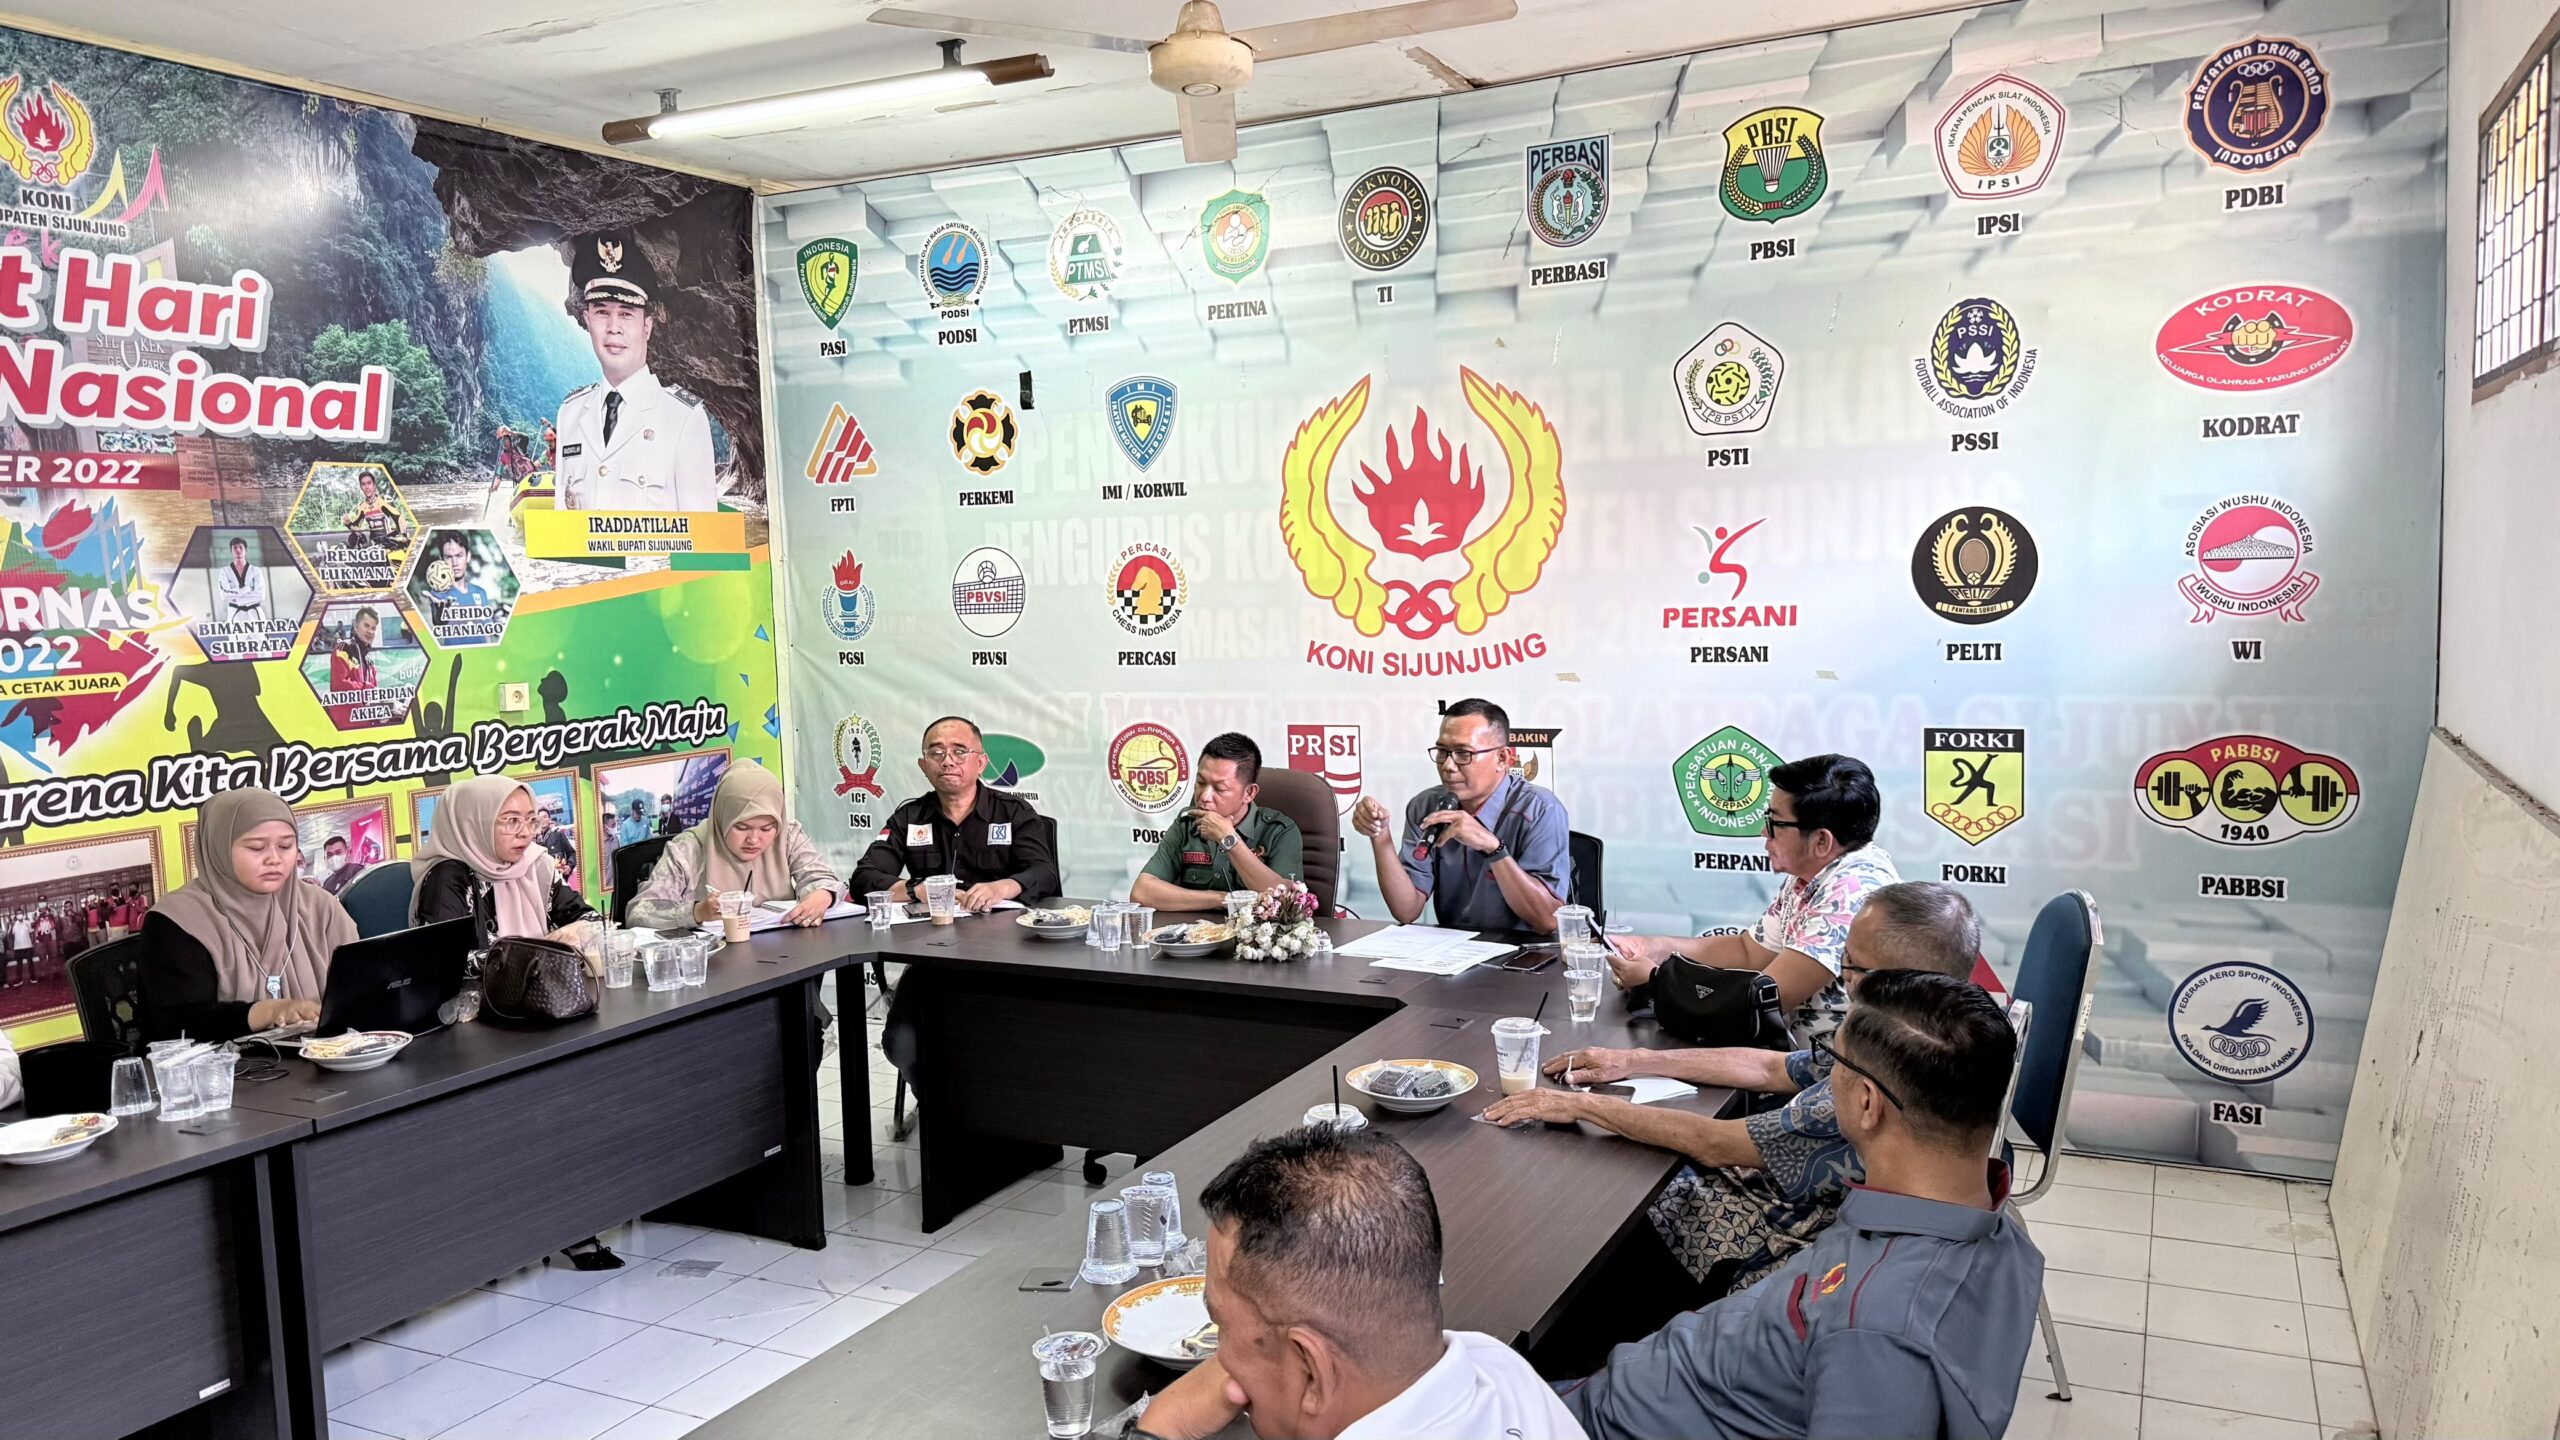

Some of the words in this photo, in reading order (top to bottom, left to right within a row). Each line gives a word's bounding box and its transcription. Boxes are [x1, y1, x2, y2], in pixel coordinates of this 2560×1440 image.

[2192, 45, 2252, 110] PERSATUAN
[2257, 43, 2301, 63] DRUM
[2299, 56, 2322, 95] BAND
[1948, 117, 1964, 147] IKATAN
[1962, 94, 1997, 117] PENCAK
[1998, 91, 2023, 101] SILAT
[2023, 96, 2051, 136] INDONESIA
[1745, 117, 1798, 148] PBSI
[1531, 139, 1604, 176] PERBASI
[2215, 139, 2297, 165] INDONESIA
[1978, 175, 2020, 190] IPSI
[22, 189, 72, 211] KONI
[1346, 172, 1422, 215] TAEKWONDO
[2225, 184, 2284, 210] PDBI
[52, 215, 127, 238] SIJUNJUNG
[930, 225, 945, 240] RAGA
[946, 223, 969, 231] DAYUNG
[1977, 213, 2020, 235] IPSI
[803, 242, 849, 258] INDONESIA
[970, 228, 987, 256] SELURUH
[1347, 229, 1421, 264] INDONESIA
[1751, 239, 1795, 261] PBSI
[848, 259, 857, 295] Indonesia
[920, 259, 934, 299] PERSATUAN
[975, 258, 989, 295] INDONESIA
[1066, 260, 1110, 282] PTMSI
[1531, 261, 1606, 286] PERBASI
[800, 263, 813, 302] Persatuan
[62, 256, 260, 341] Hari
[1377, 286, 1392, 303] TI
[2194, 289, 2314, 317] KODRAT
[941, 309, 969, 319] PODSI
[1208, 301, 1267, 321] PERTINA
[1069, 316, 1109, 333] PTMSI
[1957, 325, 1994, 339] PSSI
[938, 329, 977, 345] PODSI
[820, 341, 846, 356] PASI
[2158, 353, 2204, 382] KELUARGA
[2206, 376, 2264, 385] OLAHRAGA
[2265, 368, 2308, 383] TARUNG
[2309, 339, 2350, 372] DERAJAT
[0, 345, 384, 433] Nasional
[1126, 383, 1156, 393] IMI
[1914, 357, 1940, 402] FOOTBALL
[1936, 398, 1995, 419] ASSOCIATION
[1996, 396, 2009, 409] OF
[2008, 348, 2038, 399] INDONESIA
[1724, 408, 1749, 424] PSTI
[2203, 414, 2300, 438] KODRAT
[1111, 401, 1124, 432] IKATAN
[1120, 433, 1142, 460] MOTOR
[1145, 395, 1172, 460] INDONESIA
[1951, 432, 1999, 451] PSSI
[1707, 448, 1749, 467] PSTI
[50, 458, 143, 484] 2022
[959, 490, 1014, 506] PERKEMI
[1102, 485, 1123, 500] IMI
[1133, 482, 1187, 499] KORWIL
[831, 498, 855, 512] FPTI
[589, 518, 689, 533] IRADDATILLAH
[2185, 506, 2219, 557] ASOSIASI
[2219, 494, 2269, 510] WUSHU
[2271, 498, 2313, 554] INDONESIA
[327, 549, 386, 562] RENGGI
[588, 540, 615, 552] WAKIL
[618, 540, 647, 552] BUPATI
[648, 540, 692, 551] SIJUNJUNG
[1120, 542, 1172, 560] PERCASI
[320, 567, 396, 581] LUKMANA
[966, 590, 1007, 603] PBVSI
[1950, 588, 1999, 600] PELTI
[2197, 583, 2235, 610] WUSHU
[2238, 583, 2302, 611] INDONESIA
[0, 586, 160, 631] RNAS
[442, 607, 493, 620] AFRIDO
[1663, 605, 1798, 629] PERSANI
[1951, 606, 1978, 614] PANTANG
[1979, 605, 1998, 613] SURUT
[199, 618, 300, 636] BIMANTARA
[432, 623, 503, 638] CHANIAGO
[1112, 609, 1137, 634] CHESS
[1138, 608, 1182, 637] INDONESIA
[211, 640, 291, 656] SUBRATA
[1306, 640, 1374, 674] KONI
[1383, 633, 1547, 677] SIJUNJUNG
[1690, 646, 1769, 663] PERSANI
[1946, 643, 2002, 661] PELTI
[2231, 641, 2262, 660] WI
[839, 652, 865, 665] PGSI
[972, 652, 1007, 666] PBVSI
[1118, 651, 1177, 666] PERCASI
[11, 680, 65, 695] CETAK
[68, 676, 122, 692] JUARA
[322, 690, 361, 706] ANDRI
[364, 686, 415, 701] FERDIAN
[351, 706, 391, 720] AKHZA
[1290, 735, 1357, 756] PRSI
[1509, 732, 1548, 743] BAKIN
[1934, 732, 2015, 748] FORKI
[156, 757, 260, 803] Kita
[273, 738, 464, 790] Bersama
[477, 714, 638, 771] Bergerak
[645, 700, 723, 746] Maju
[1111, 730, 1135, 770] PERSATUAN
[2210, 743, 2281, 764] PABBSI
[1685, 739, 1737, 799] PERSATUAN
[851, 792, 867, 803] ICF
[1118, 784, 1147, 809] SELURUH
[1148, 786, 1182, 810] INDONESIA
[1709, 795, 1753, 810] PERPANI
[850, 815, 871, 828] ISSI
[1697, 807, 1766, 829] INDONESIA
[2220, 824, 2270, 841] 1940
[1694, 853, 1771, 872] PERPANI
[1942, 864, 2006, 884] FORKI
[2201, 876, 2285, 899] PABBSI
[2178, 978, 2209, 1014] FEDERASI
[2209, 970, 2236, 982] AERO
[2238, 970, 2272, 984] SPORT
[2271, 981, 2304, 1027] INDONESIA
[2181, 1033, 2194, 1051] EKA
[2192, 1049, 2213, 1067] DAYA
[2213, 1062, 2272, 1076] DIRGANTARA
[2271, 1046, 2299, 1070] KARMA
[2213, 1103, 2262, 1125] FASI
